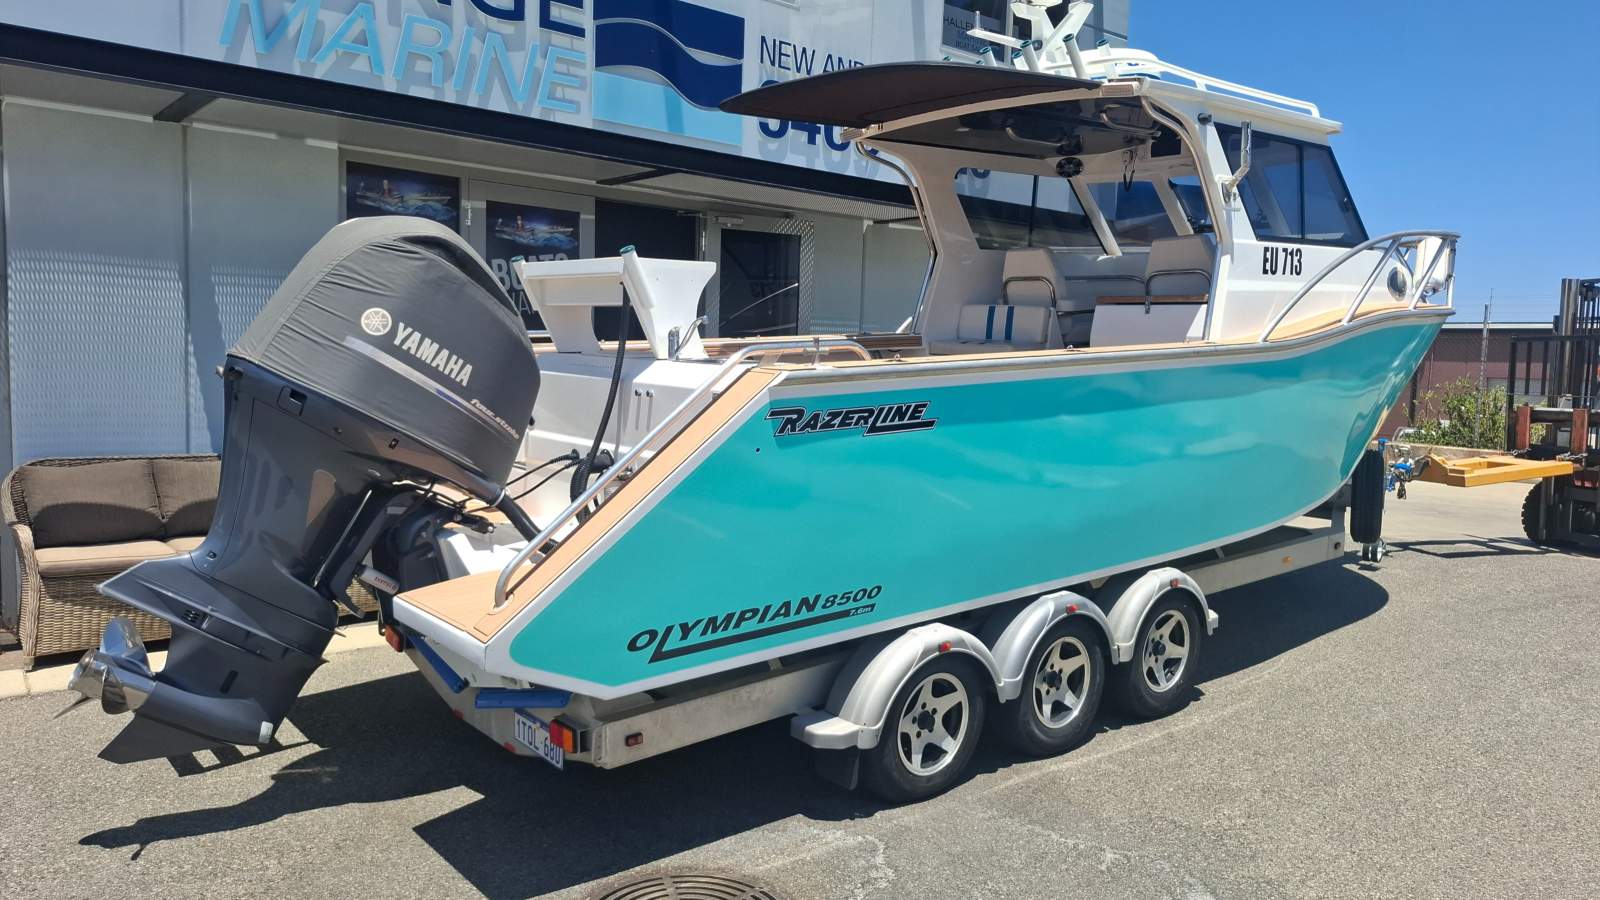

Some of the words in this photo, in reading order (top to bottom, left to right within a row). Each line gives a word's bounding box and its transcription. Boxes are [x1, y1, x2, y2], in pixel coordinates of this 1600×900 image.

[219, 0, 588, 113] MARINE
[760, 35, 816, 75] NEW
[1262, 246, 1279, 276] EU
[1282, 247, 1303, 276] 713
[393, 322, 473, 387] YAMAHA
[764, 401, 939, 437] RAZERLINE
[626, 593, 822, 664] OLYMPIAN
[821, 585, 882, 610] 8500
[849, 606, 873, 616] 7.6m
